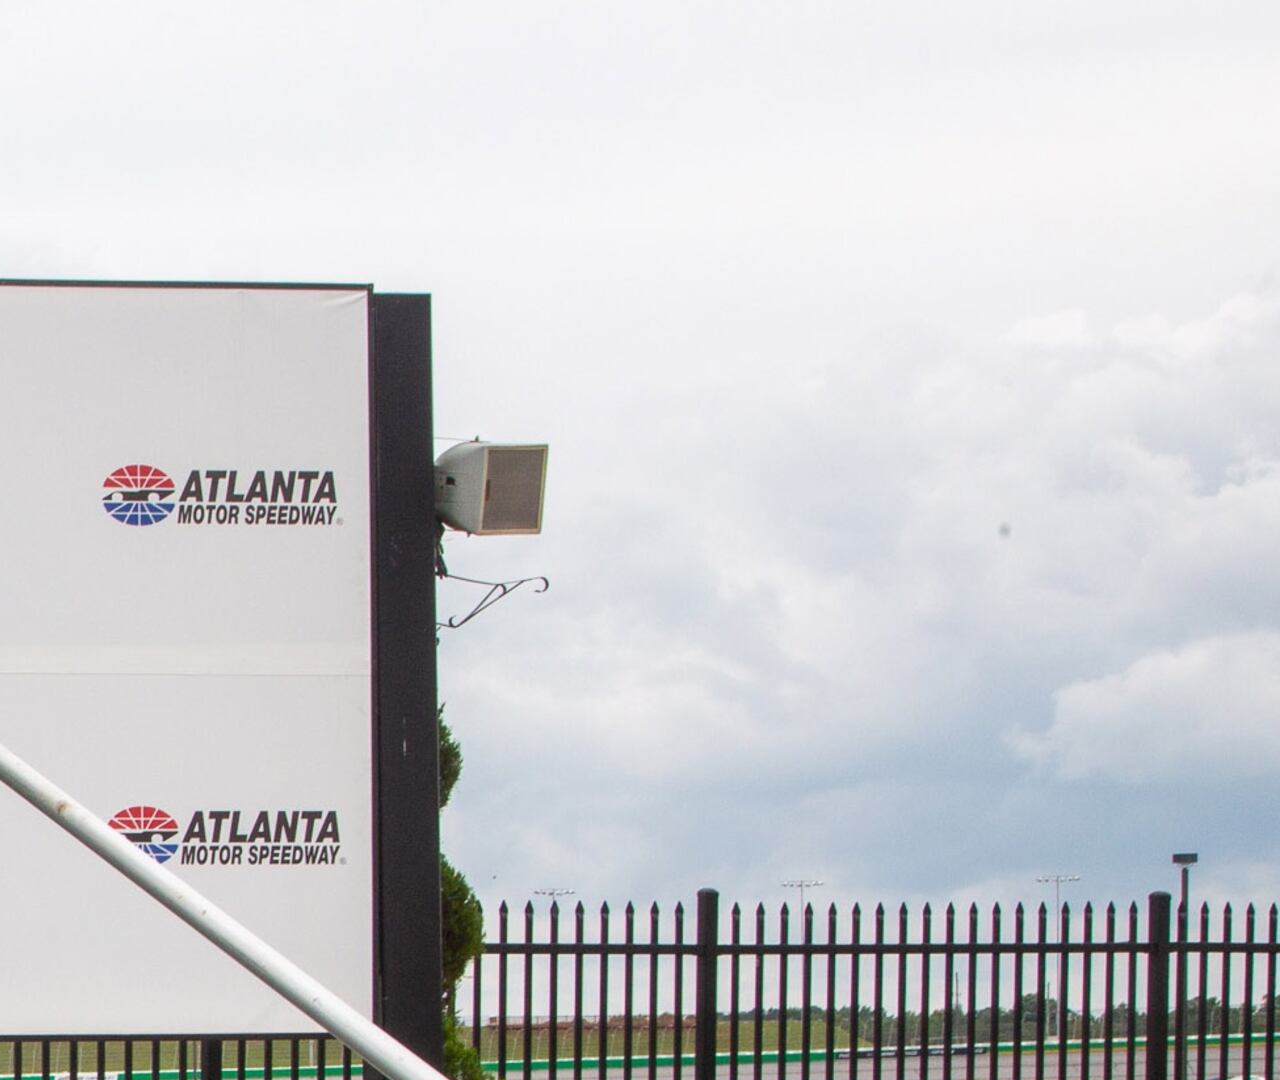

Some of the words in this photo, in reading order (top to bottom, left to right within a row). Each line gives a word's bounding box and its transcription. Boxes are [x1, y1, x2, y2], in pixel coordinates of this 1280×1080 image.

[179, 470, 338, 503] ATLANTA
[177, 505, 240, 524] MOTOR
[244, 505, 338, 525] SPEEDWAY
[182, 810, 340, 843] ATLANTA
[181, 845, 243, 865] MOTOR
[247, 845, 340, 865] SPEEDWAY
